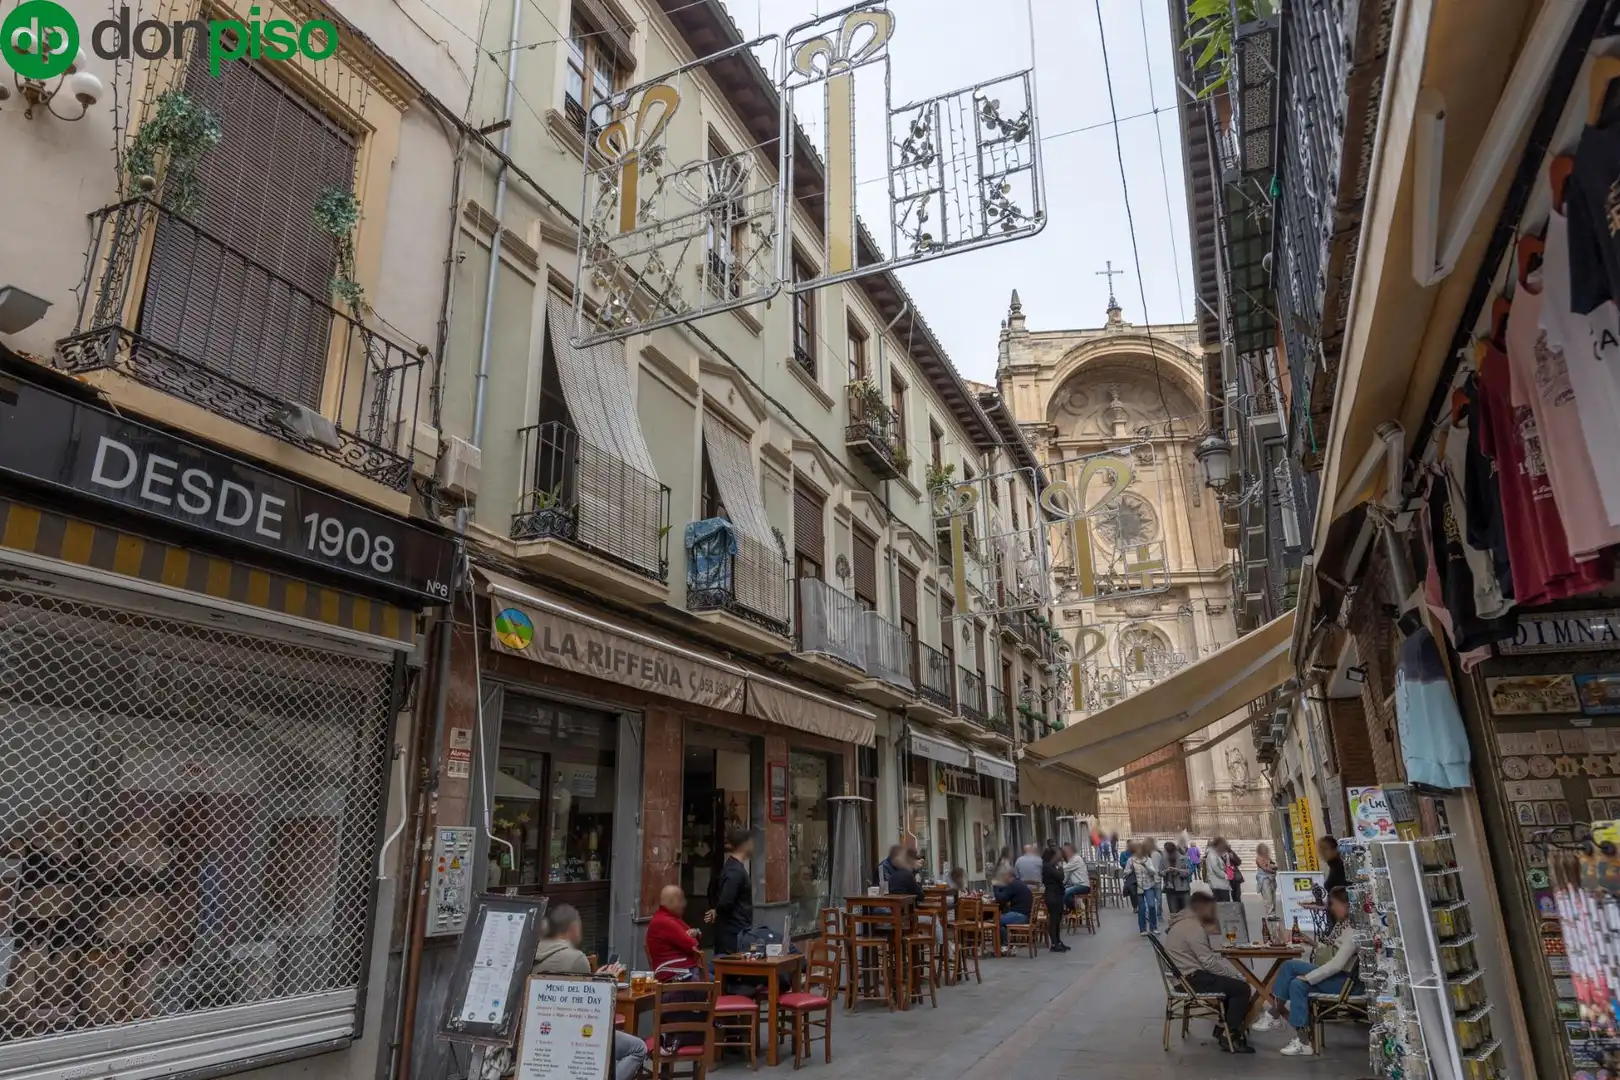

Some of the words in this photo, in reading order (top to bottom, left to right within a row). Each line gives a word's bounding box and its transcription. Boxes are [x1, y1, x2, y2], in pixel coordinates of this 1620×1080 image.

[90, 436, 286, 540] DESDE
[303, 512, 395, 574] 1908
[426, 579, 448, 597] Nº6
[543, 626, 578, 661] LA
[587, 639, 683, 689] RIFFEÑA
